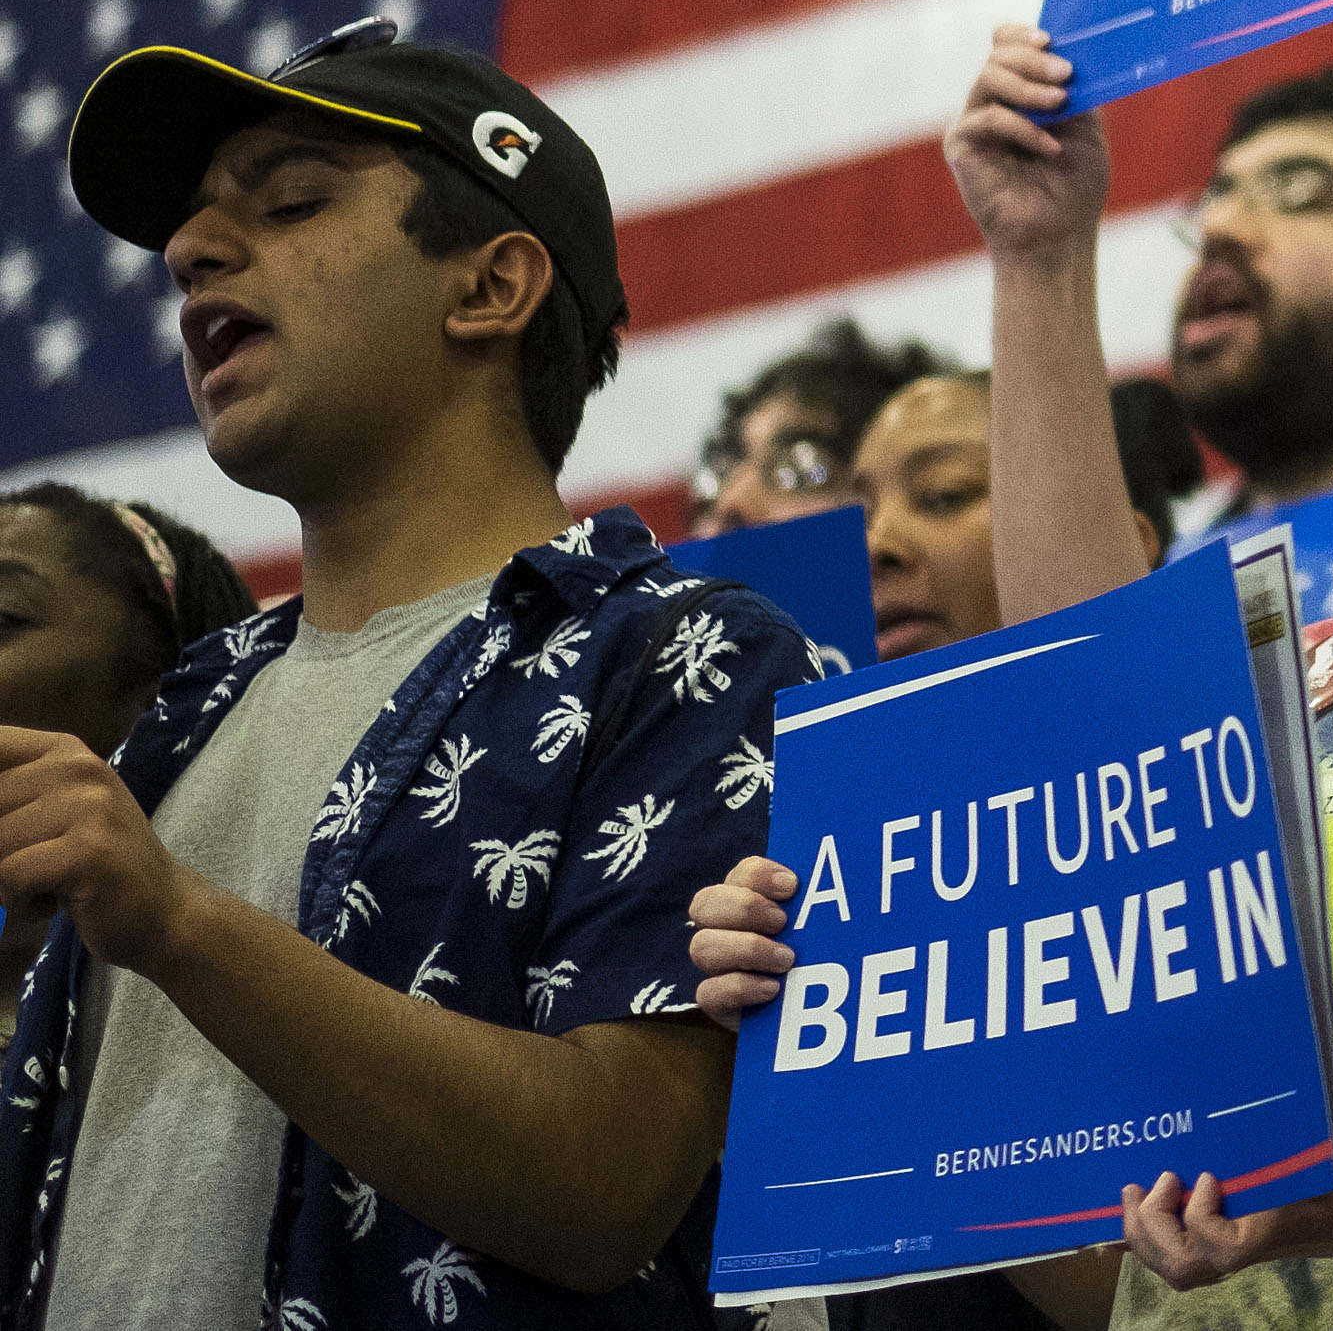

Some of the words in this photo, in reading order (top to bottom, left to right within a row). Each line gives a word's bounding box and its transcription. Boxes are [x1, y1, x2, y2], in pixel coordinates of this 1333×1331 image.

[793, 834, 851, 931] A
[880, 745, 1177, 915] FUTURE
[1181, 714, 1255, 829] TO
[773, 880, 1198, 1073] BELIEVE
[1208, 849, 1288, 984] IN
[935, 1108, 1194, 1178] BERNIESANDERS.COM
